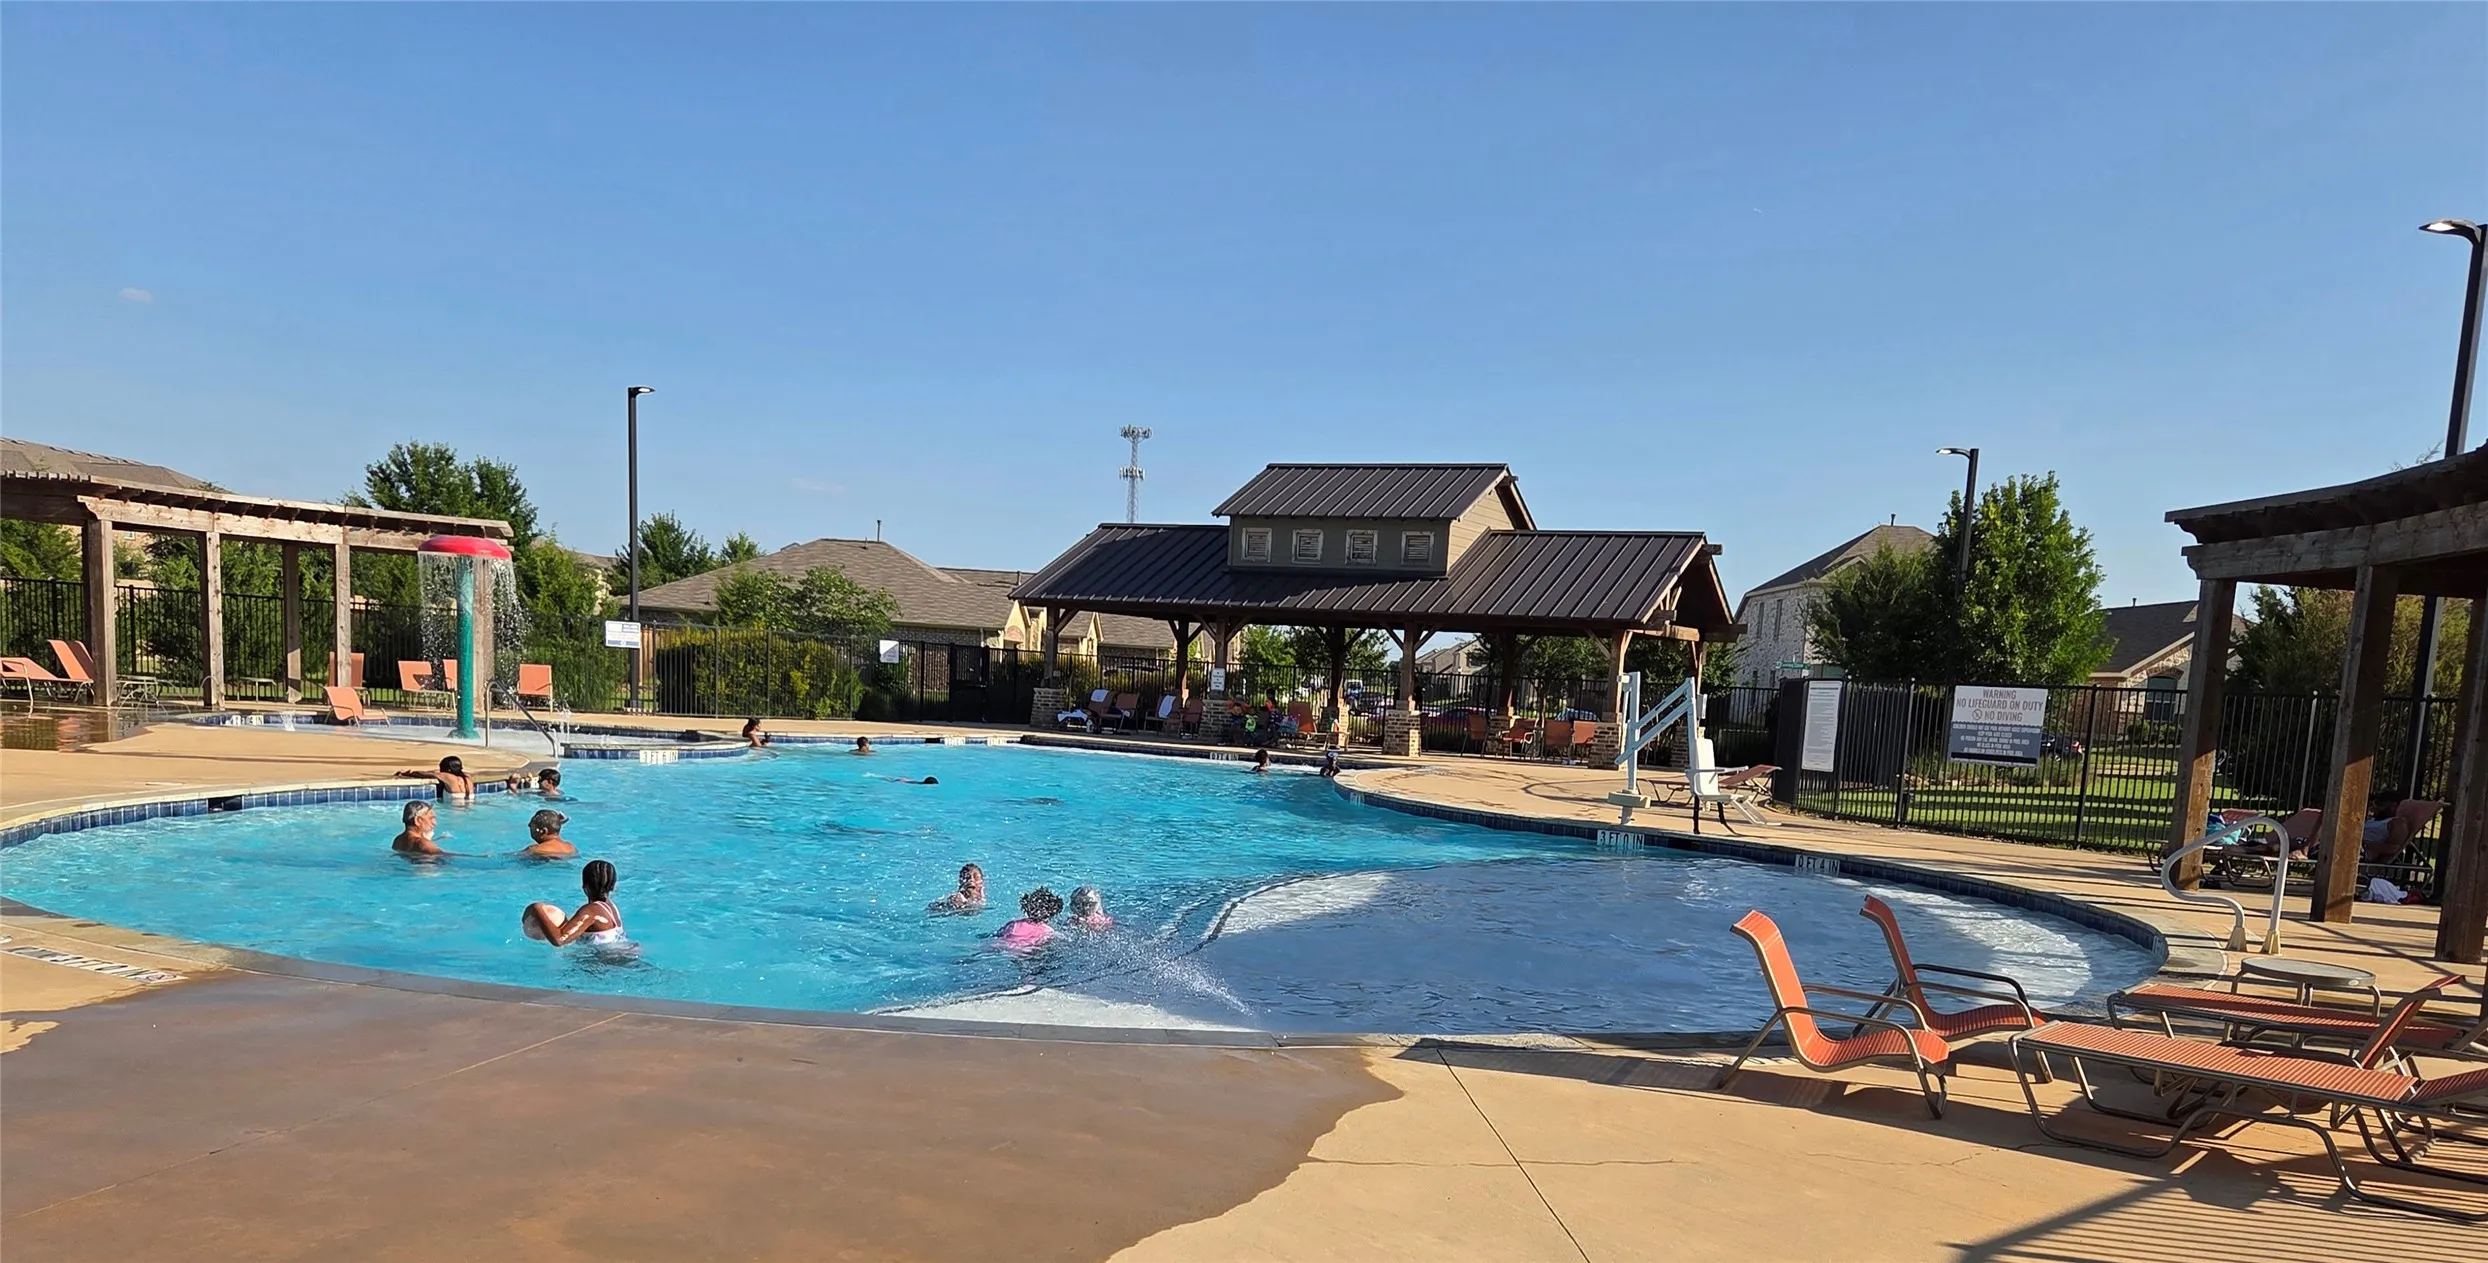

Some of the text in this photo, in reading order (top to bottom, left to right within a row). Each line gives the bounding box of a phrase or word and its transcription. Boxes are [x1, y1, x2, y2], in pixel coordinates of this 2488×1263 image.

[1983, 689, 2017, 699] WARNING
[1956, 698, 2043, 711] NO LIFEGUARD ON DUTY
[1985, 711, 2023, 722] NO DIVING
[1601, 831, 1606, 843] 3
[1609, 832, 1620, 845] FT
[1633, 834, 1643, 847] IN
[1806, 857, 1816, 868] FT
[1829, 859, 1838, 871] IN
